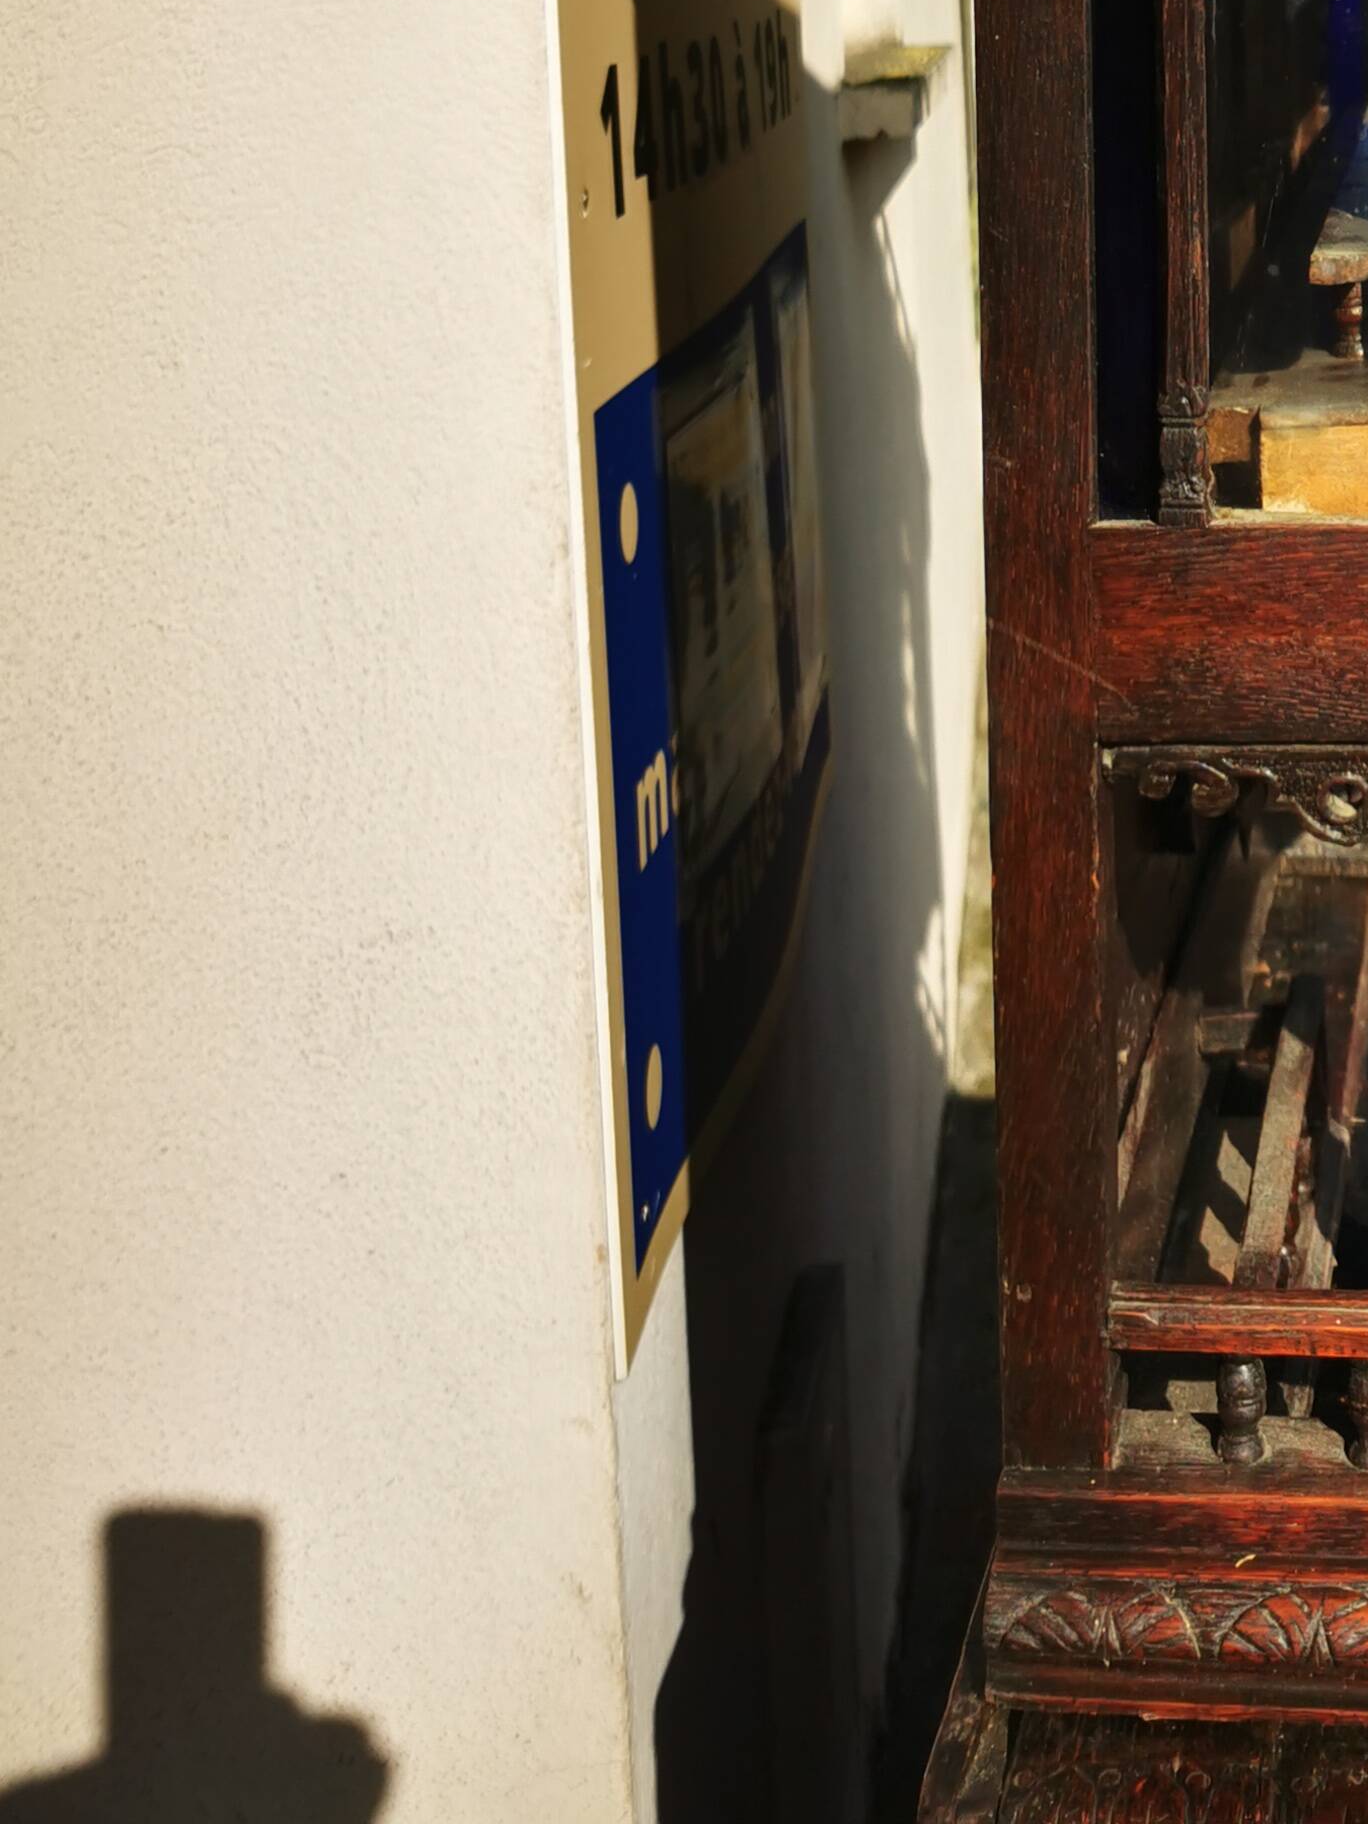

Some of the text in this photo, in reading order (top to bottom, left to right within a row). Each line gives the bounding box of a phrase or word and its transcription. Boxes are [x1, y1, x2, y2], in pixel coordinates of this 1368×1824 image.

[600, 8, 793, 219] 14h30 à 19h
